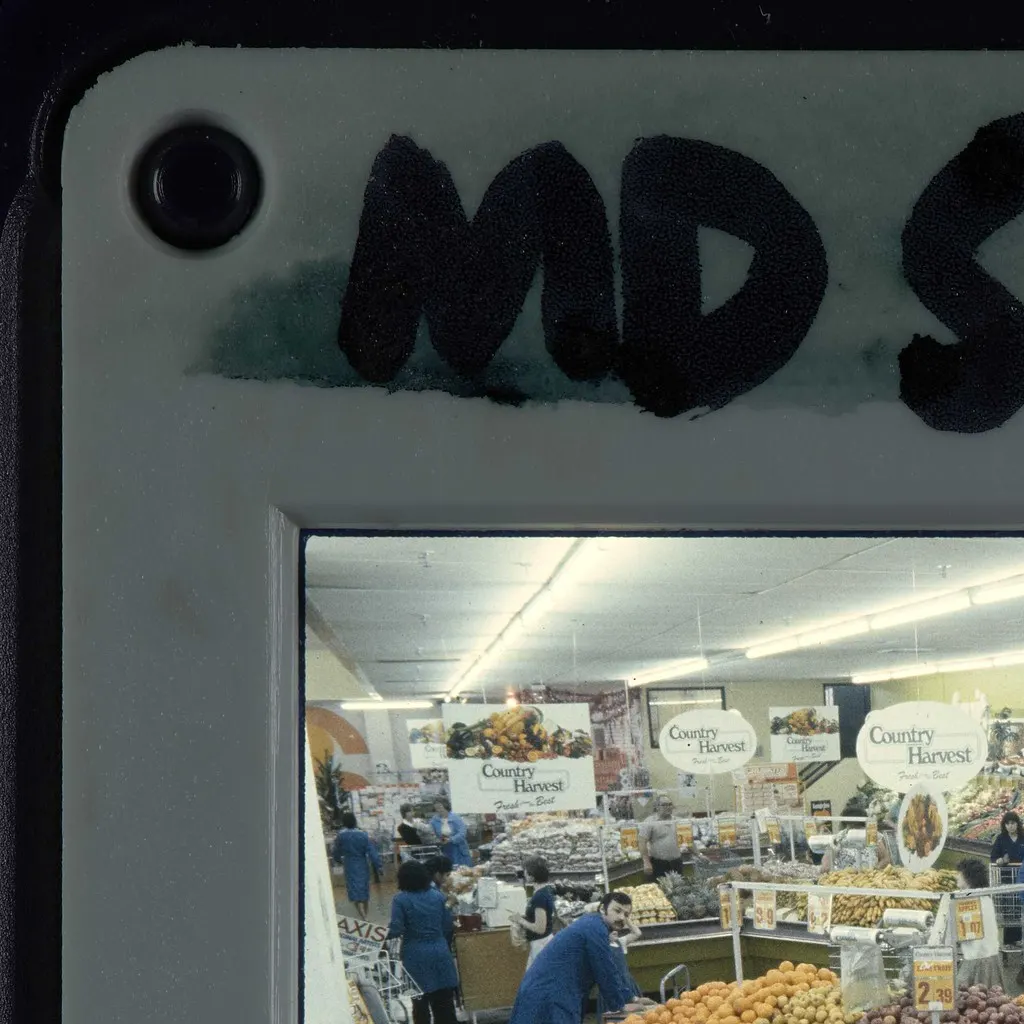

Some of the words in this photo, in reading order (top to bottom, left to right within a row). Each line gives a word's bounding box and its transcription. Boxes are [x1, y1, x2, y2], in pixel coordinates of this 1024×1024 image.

[336, 132, 829, 418] MD
[669, 725, 718, 740] Country
[869, 725, 934, 746] Country
[699, 740, 745, 754] Harvest
[787, 736, 812, 745] Country
[908, 747, 973, 765] Harvest
[482, 764, 535, 779] Country
[513, 779, 564, 793] Harvest
[493, 800, 519, 813] Fresh
[536, 795, 556, 807] Best
